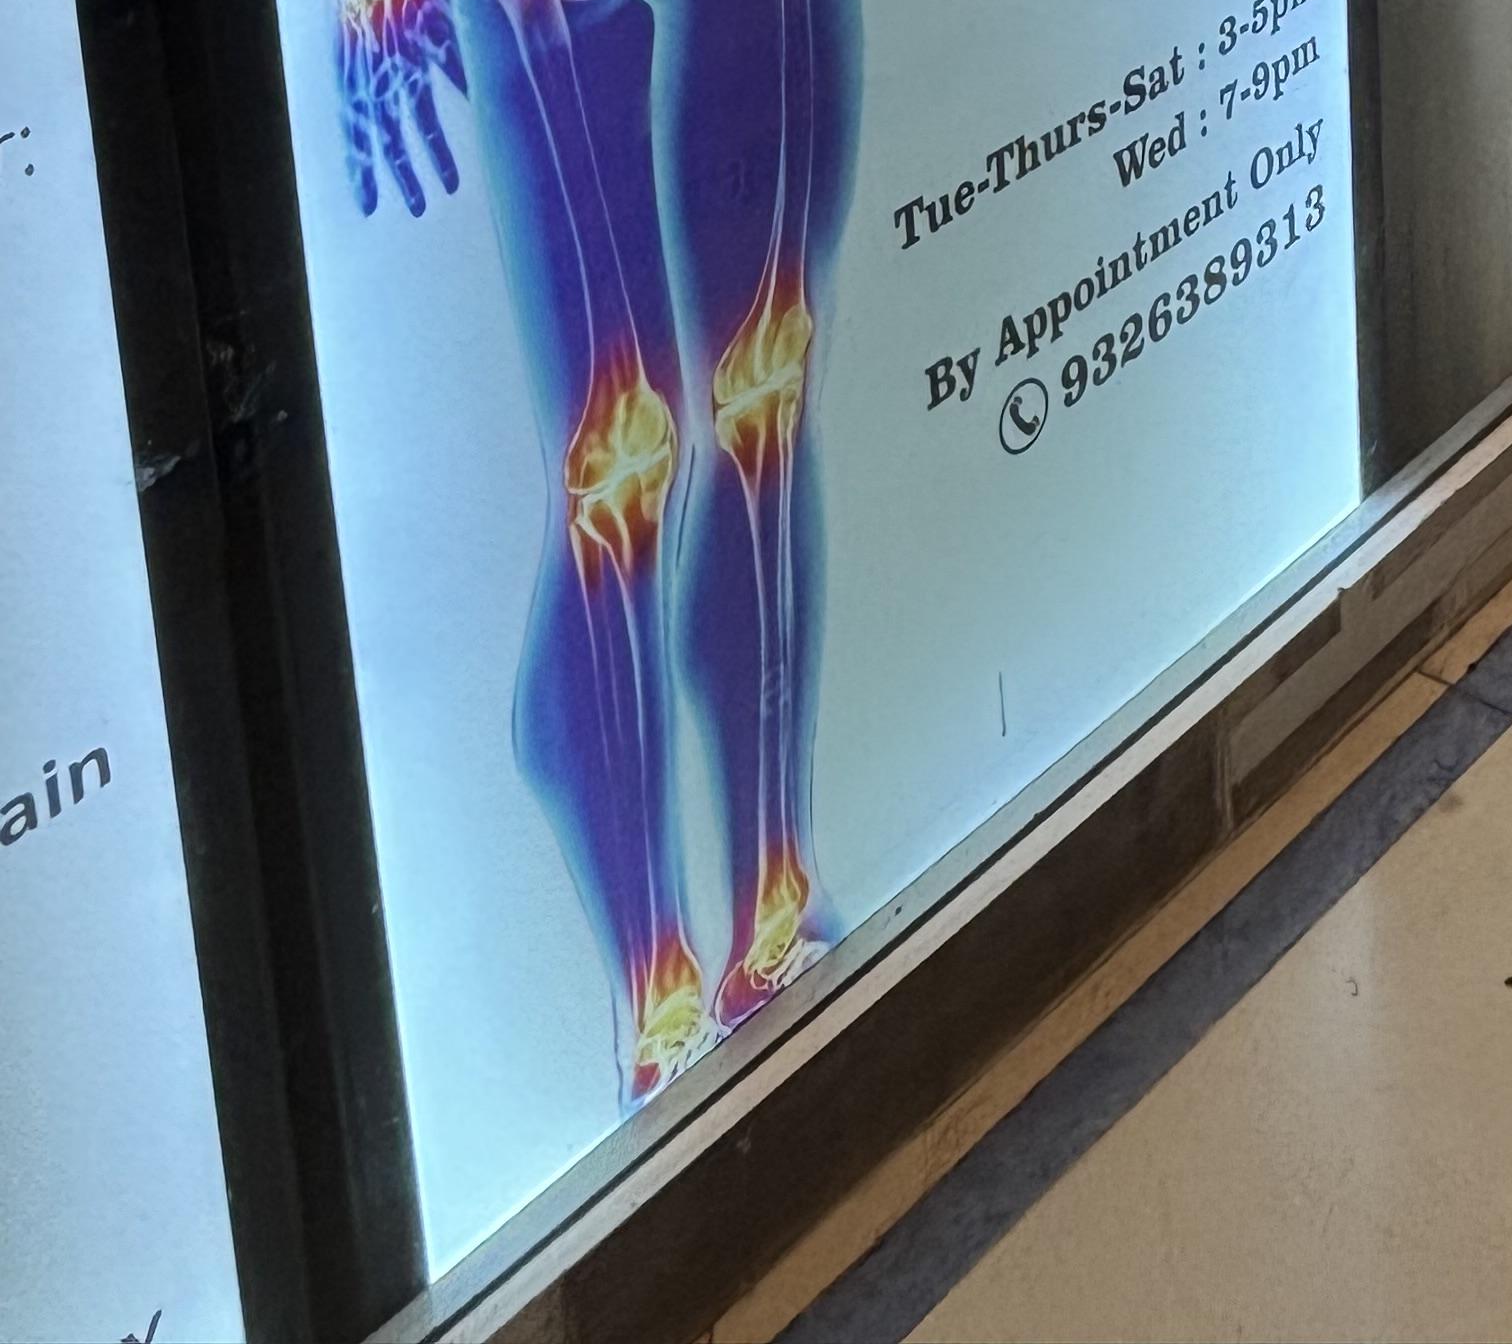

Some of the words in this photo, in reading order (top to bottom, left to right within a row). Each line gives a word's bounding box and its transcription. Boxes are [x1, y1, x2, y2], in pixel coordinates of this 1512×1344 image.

[893, 45, 1186, 251] Tue-Thurs-Sat
[1112, 111, 1188, 188] Wed
[1219, 35, 1321, 120] 7-9pm
[924, 347, 981, 412] By
[994, 170, 1240, 367] Appointment
[1249, 117, 1325, 191] Only
[1061, 183, 1327, 408] 9326389313
